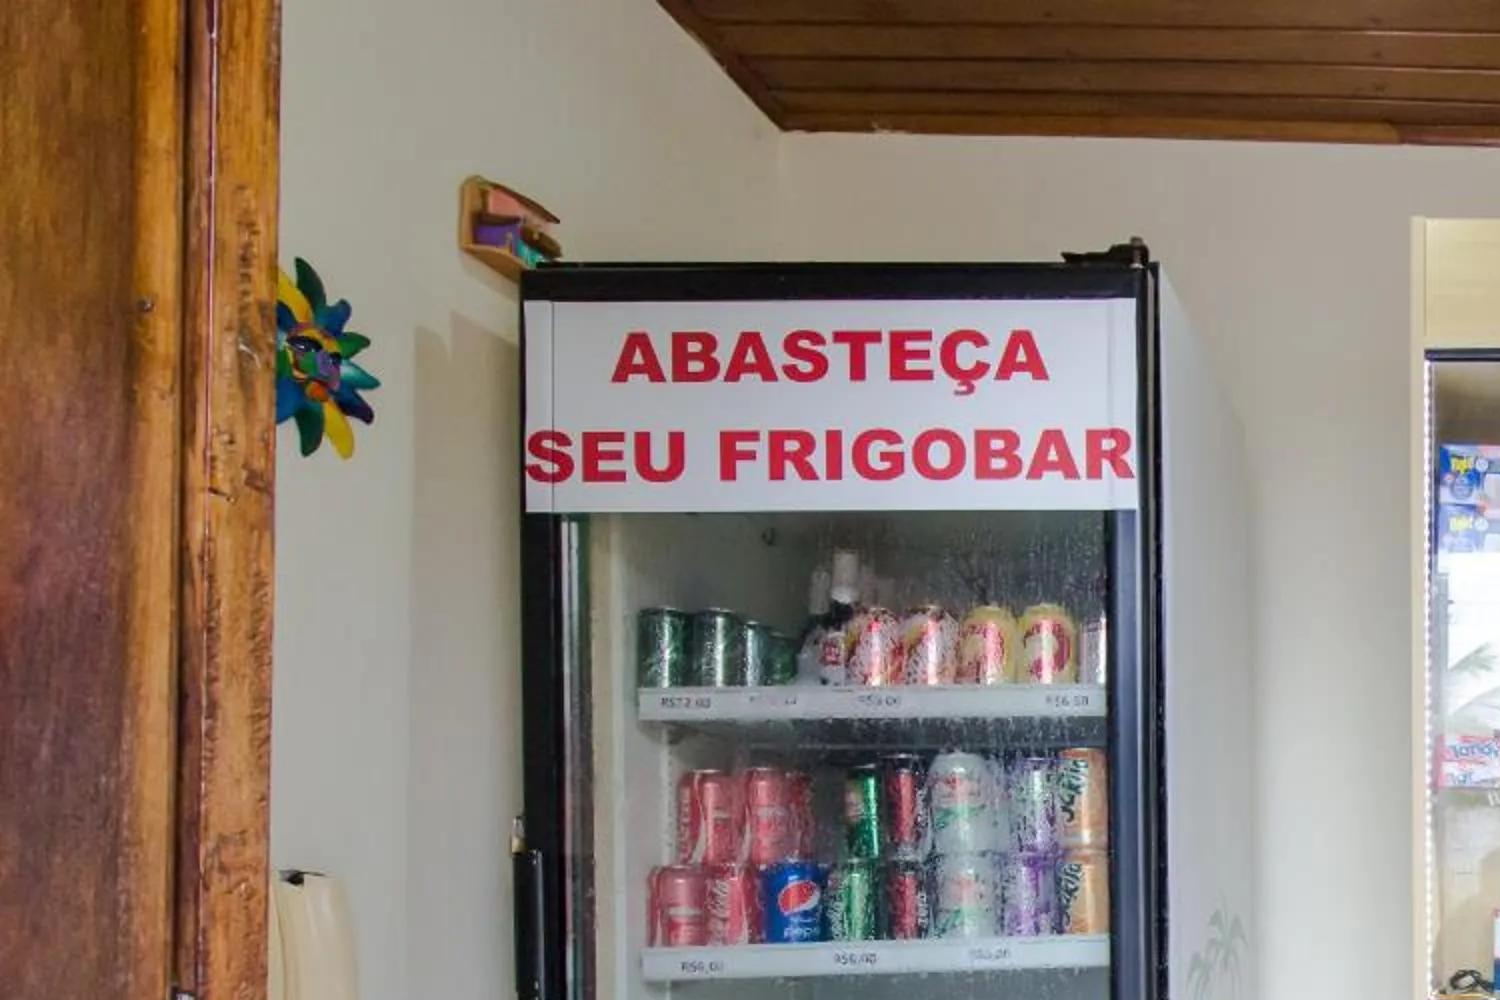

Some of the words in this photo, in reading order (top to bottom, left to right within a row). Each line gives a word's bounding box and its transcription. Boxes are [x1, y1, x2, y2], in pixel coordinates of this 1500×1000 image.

[611, 329, 1049, 396] ABASTEÇA
[525, 429, 686, 483] SEU
[719, 427, 1136, 482] FRIGOBAR
